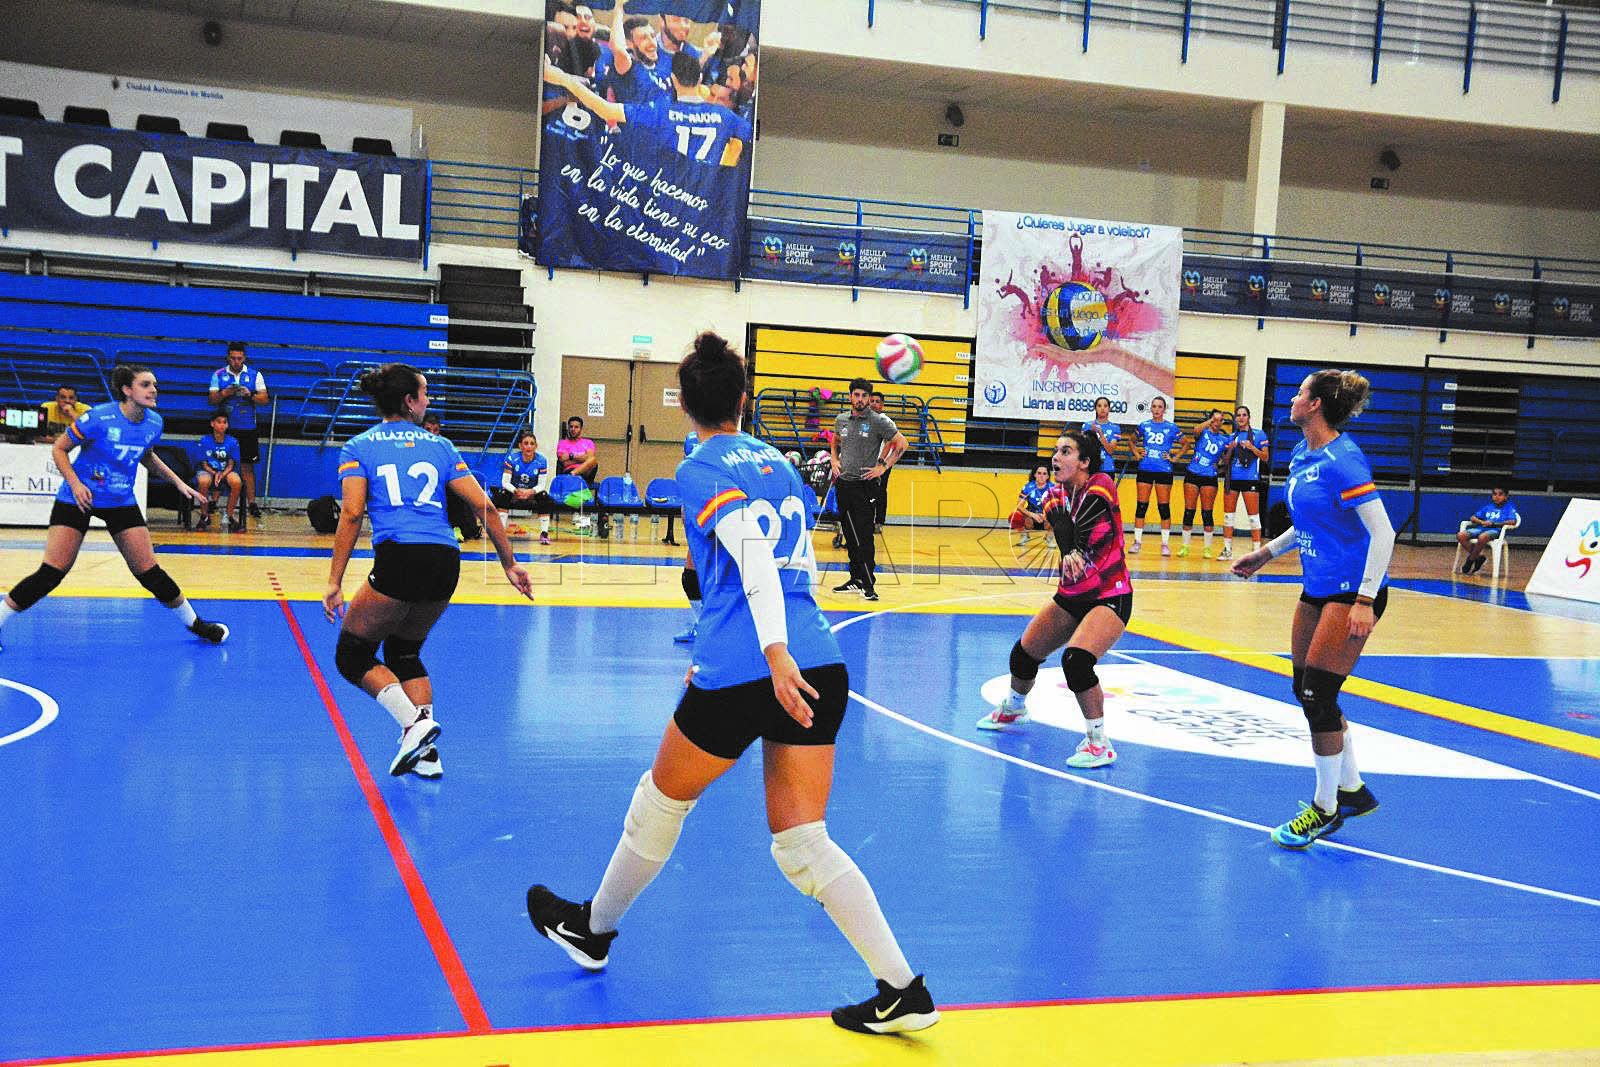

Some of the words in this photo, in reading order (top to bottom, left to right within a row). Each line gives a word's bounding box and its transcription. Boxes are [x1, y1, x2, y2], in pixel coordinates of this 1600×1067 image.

[675, 125, 717, 161] 17
[54, 143, 419, 241] CAPITAL
[622, 161, 648, 186] que
[650, 167, 709, 212] hacemos
[560, 164, 583, 184] en
[587, 165, 607, 193] la
[609, 184, 641, 209] vida
[643, 197, 681, 228] tiene
[681, 222, 700, 239] su
[700, 231, 731, 250] eco
[577, 203, 601, 224] en
[604, 204, 625, 232] la
[1016, 215, 1066, 231] ¿Quieres
[1067, 221, 1096, 236] Jugar
[1098, 225, 1105, 235] a
[1107, 226, 1151, 239] voleibol?
[785, 243, 815, 252] MELILLA
[785, 250, 809, 258] SPORT
[859, 249, 887, 258] MELILLA
[785, 257, 814, 266] CAPITAL
[858, 262, 887, 271] CAPITAL
[859, 256, 882, 264] SPORT
[930, 261, 953, 269] SPORT
[929, 267, 957, 276] CAPITAL
[1032, 380, 1119, 396] INCRIPCIONES
[1022, 395, 1055, 410] Llama
[1057, 398, 1066, 411] al
[1147, 431, 1165, 445] 28
[1205, 439, 1219, 455] 10
[114, 444, 145, 467] 77
[376, 461, 443, 509] 12
